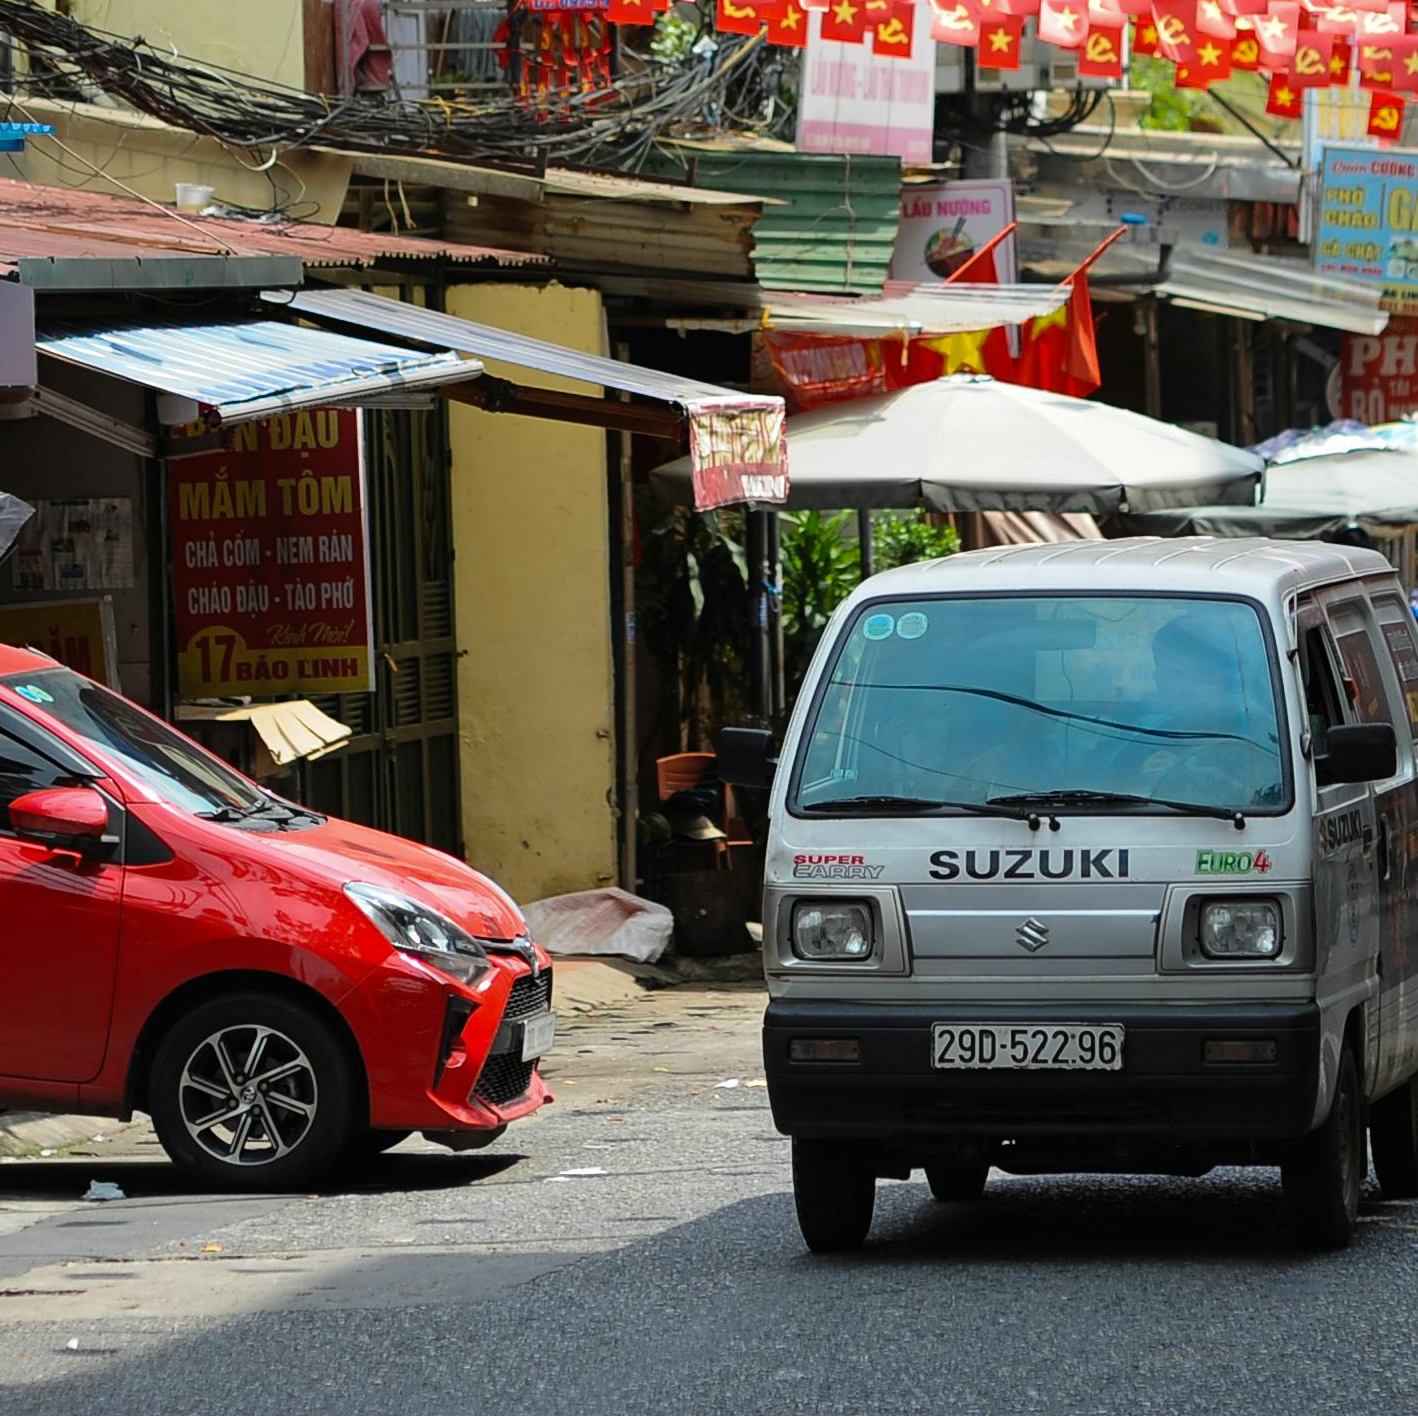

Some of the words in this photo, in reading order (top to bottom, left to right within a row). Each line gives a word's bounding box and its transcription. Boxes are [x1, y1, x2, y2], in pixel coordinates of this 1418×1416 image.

[180, 465, 267, 520] MẮM
[278, 469, 353, 517] TÔM
[277, 535, 315, 564] NEM
[318, 529, 353, 563] RÁN
[188, 580, 232, 615] CHÁO
[236, 579, 270, 619] ĐẬU
[285, 577, 316, 611] TÀO
[195, 634, 238, 683] 17
[236, 654, 289, 682] BẢO
[297, 657, 359, 680] LINH
[1326, 808, 1362, 850] SUZUKI
[793, 855, 866, 865] SUPER
[793, 865, 885, 879] CARRY
[928, 849, 1131, 880] SUZUKI
[936, 1028, 1118, 1066] 29D-522.96
